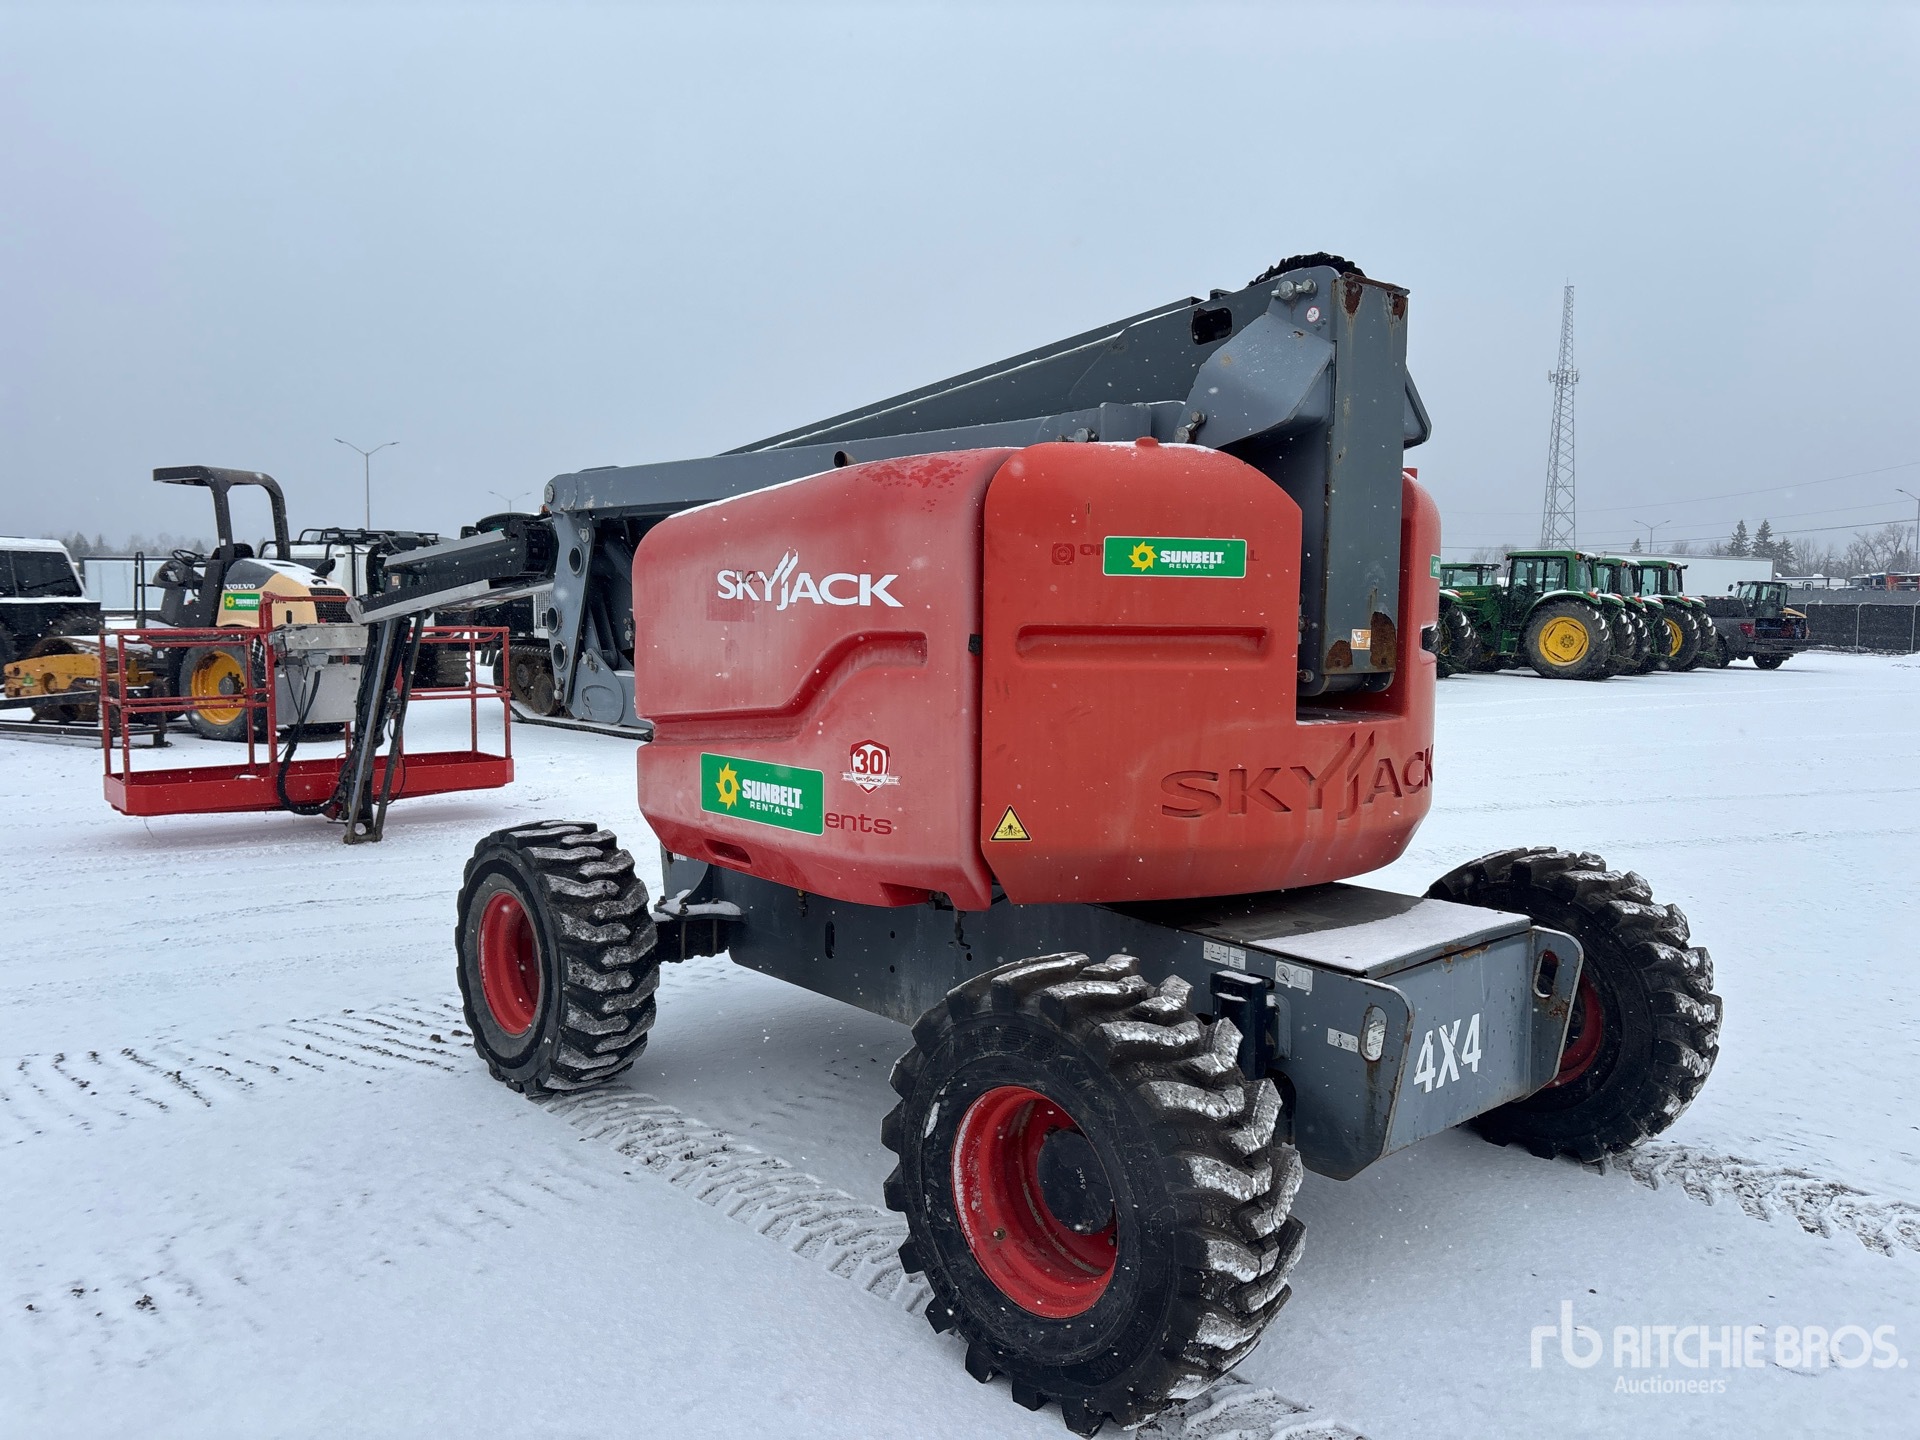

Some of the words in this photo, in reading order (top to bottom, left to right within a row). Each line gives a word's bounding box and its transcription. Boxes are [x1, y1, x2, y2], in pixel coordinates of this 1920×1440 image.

[1160, 550, 1224, 564] SUNBELT
[717, 550, 904, 611] SKYJACK
[855, 749, 884, 774] 30
[1160, 730, 1434, 820] SKYJACK
[742, 779, 802, 809] SUNBELT
[749, 801, 793, 817] RENTALS
[1413, 1013, 1482, 1093] 4X4
